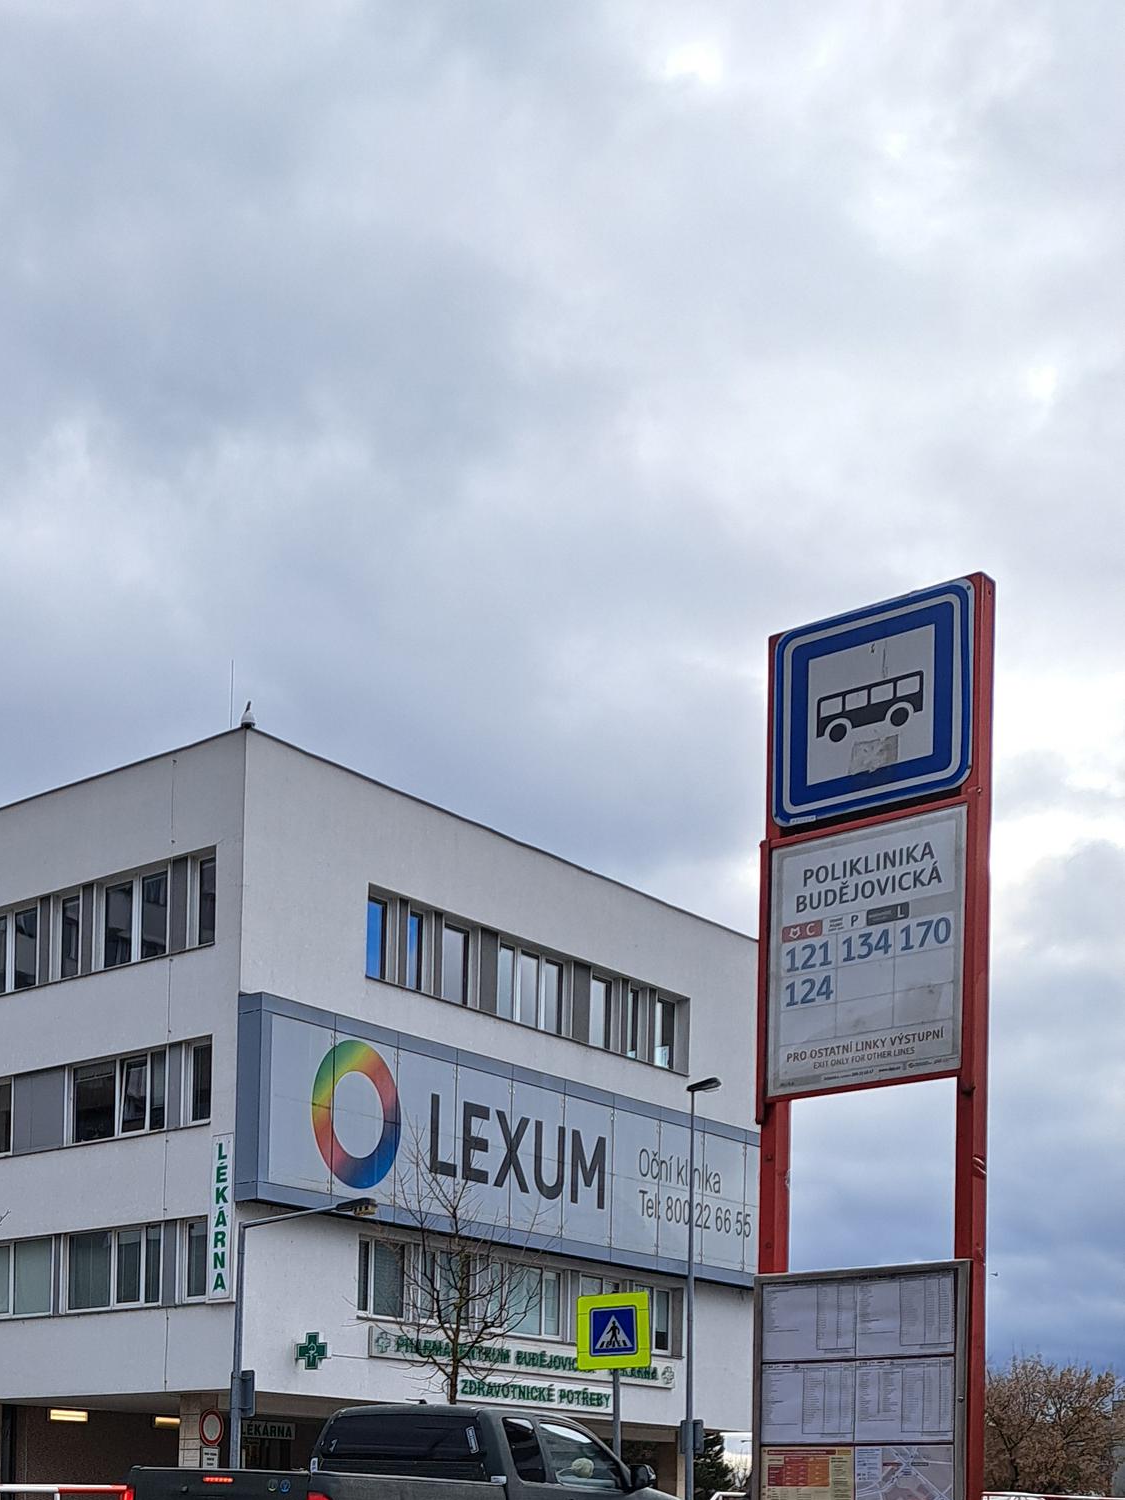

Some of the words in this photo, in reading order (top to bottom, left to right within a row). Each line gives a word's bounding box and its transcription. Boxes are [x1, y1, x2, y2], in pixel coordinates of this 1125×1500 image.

[802, 840, 935, 888] POLIKLINIKA
[795, 862, 943, 914] BUDĚJOVICKÁ
[851, 914, 859, 928] P
[896, 903, 906, 918] L
[786, 940, 832, 973] 121
[842, 928, 892, 963] 134
[900, 917, 952, 951] 170
[805, 922, 816, 937] C
[785, 974, 834, 1007] 124
[786, 1049, 807, 1063] PRO
[809, 1042, 853, 1060] OSTATNÍ
[855, 1037, 887, 1052] LINKY
[890, 1026, 944, 1047] VÝSTUPNÍ
[813, 1060, 829, 1070] EXIT
[831, 1057, 850, 1067] ONLY
[851, 1055, 866, 1064] FOR
[867, 1050, 893, 1062] OTHER
[894, 1046, 916, 1057] LINES
[429, 1093, 607, 1210] LEXUM
[638, 1148, 673, 1184] Oční
[676, 1157, 722, 1194] klnika
[212, 1142, 229, 1292] LÉKÁRNA
[665, 1196, 691, 1226] 800
[694, 1202, 712, 1230] 22
[715, 1206, 732, 1234] 66
[735, 1211, 752, 1238] 55
[394, 1335, 511, 1366] PHARMAENTRUM
[460, 1379, 555, 1405] ZDRAVOTNICKÉ
[558, 1386, 612, 1409] POTŘEBY
